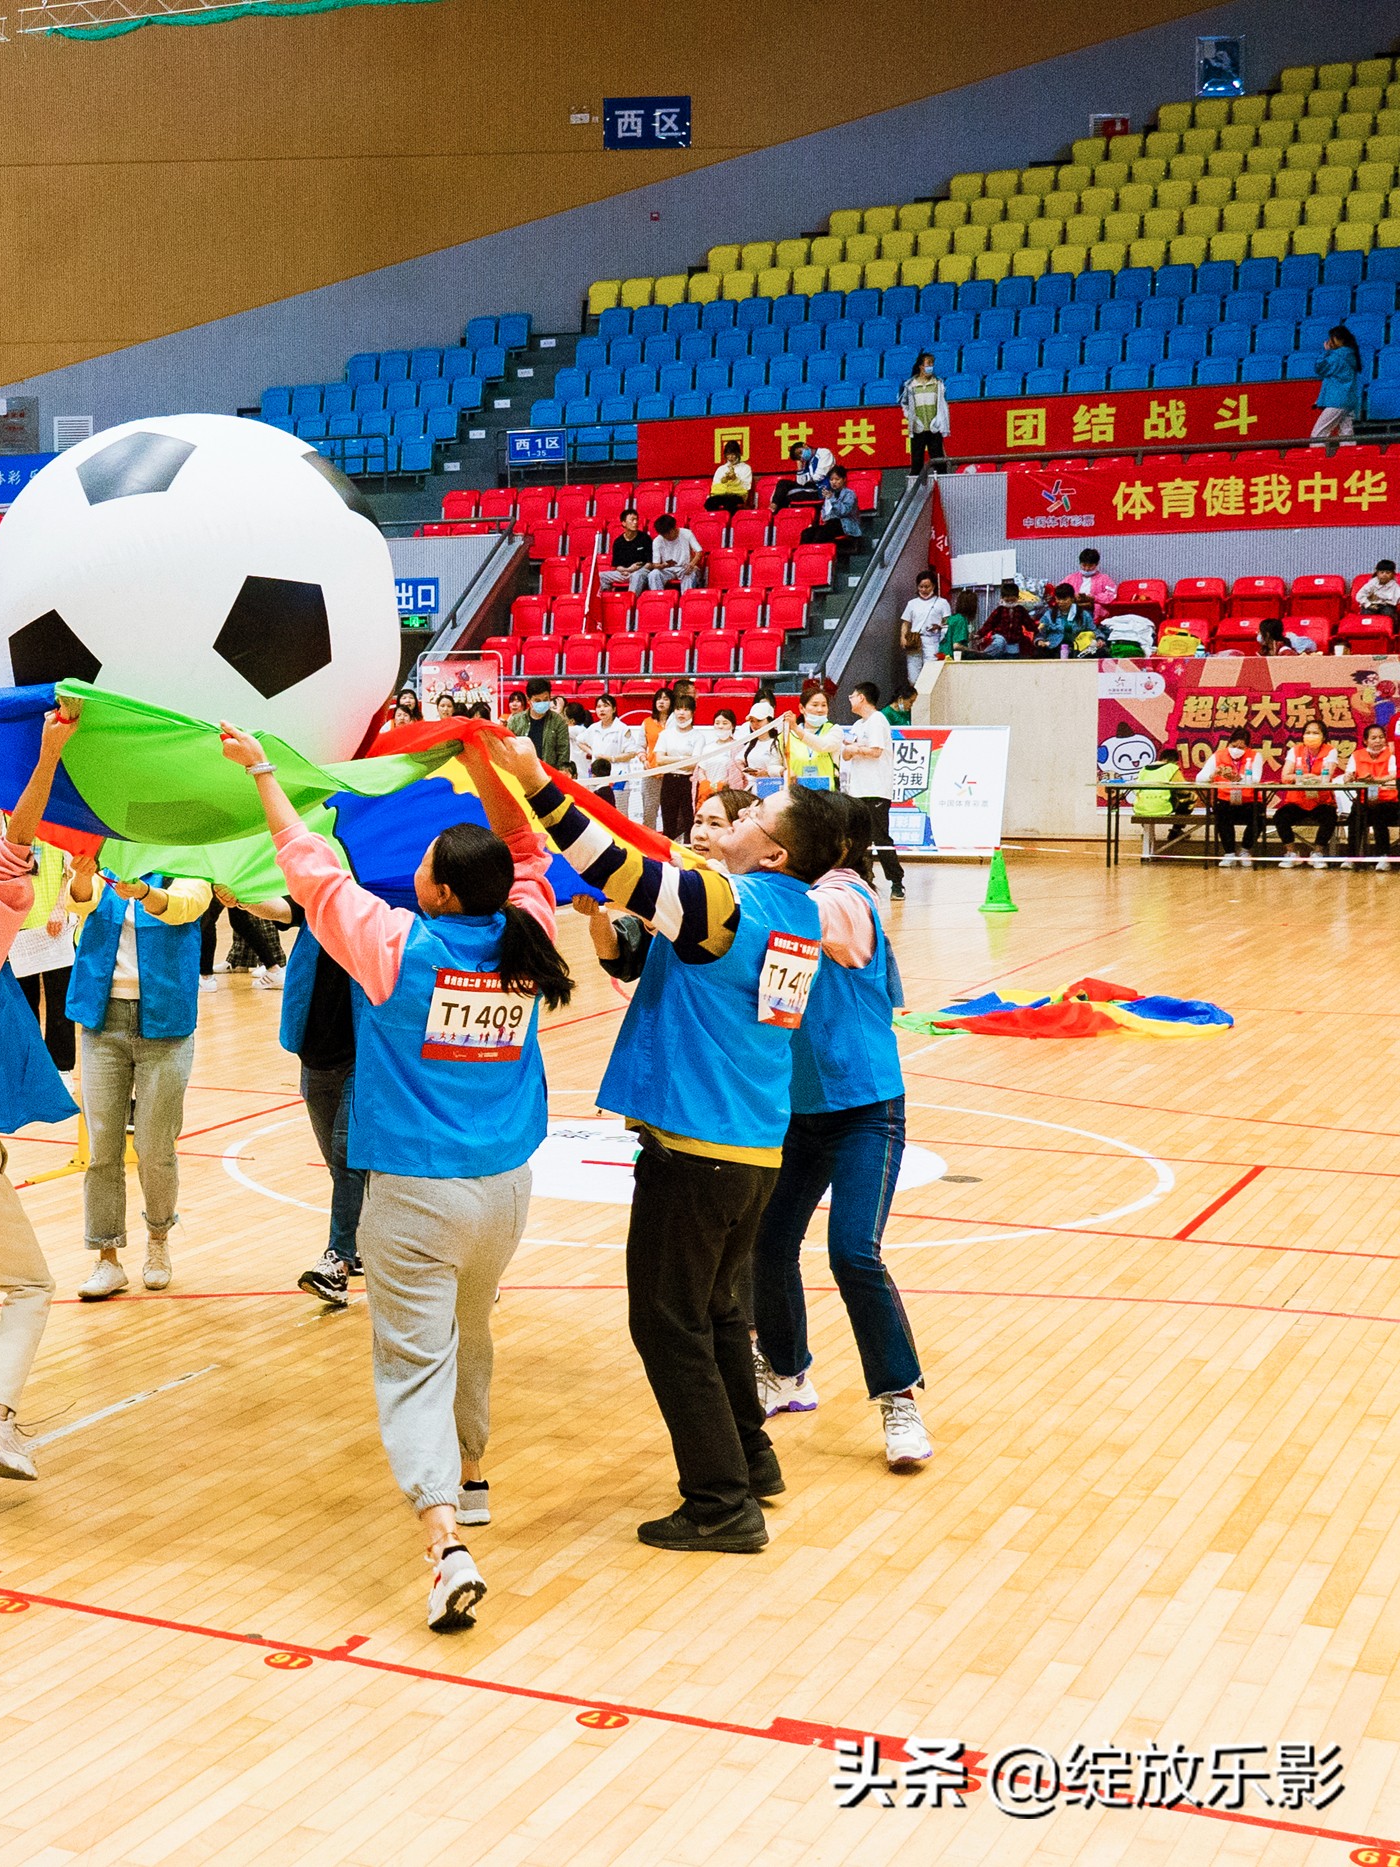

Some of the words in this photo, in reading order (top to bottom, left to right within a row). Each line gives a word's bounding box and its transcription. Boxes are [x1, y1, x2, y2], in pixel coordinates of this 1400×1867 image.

[614, 108, 682, 138] 西区
[714, 418, 912, 464] 同甘共
[1006, 394, 1258, 447] 团结战斗
[1112, 469, 1388, 521] 体育健我中华
[395, 582, 435, 610] 出口
[1179, 695, 1356, 728] 超级大乐透
[893, 772, 923, 786] 为我
[441, 1002, 523, 1028] T1409
